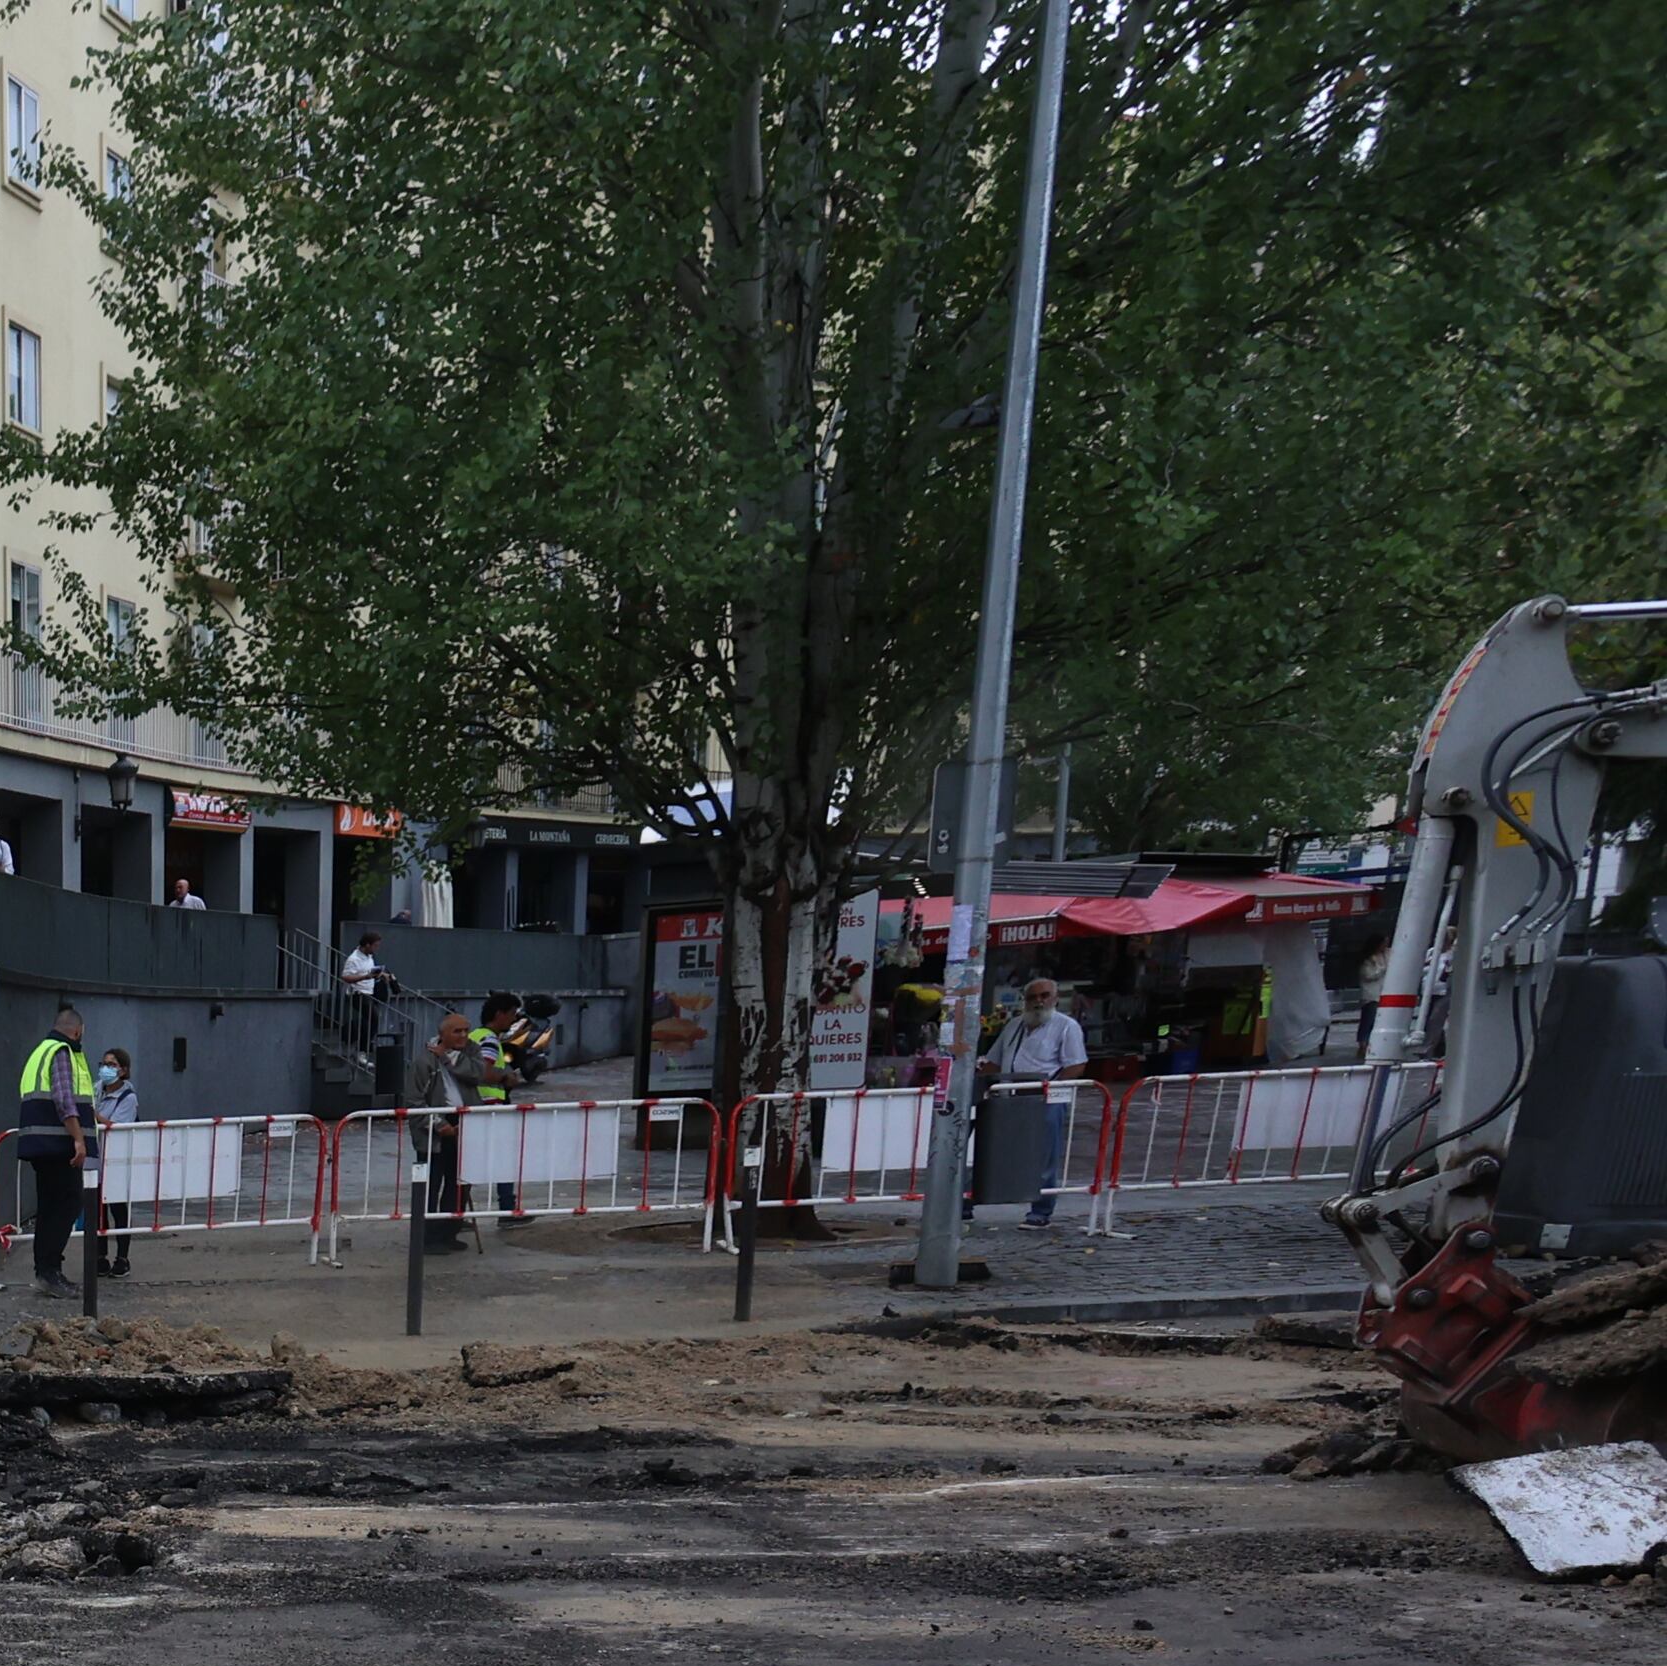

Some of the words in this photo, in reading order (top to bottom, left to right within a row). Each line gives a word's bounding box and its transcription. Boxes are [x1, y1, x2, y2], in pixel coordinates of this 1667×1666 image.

[840, 915, 866, 928] RES
[678, 944, 715, 969] EL
[824, 1019, 842, 1031] LA
